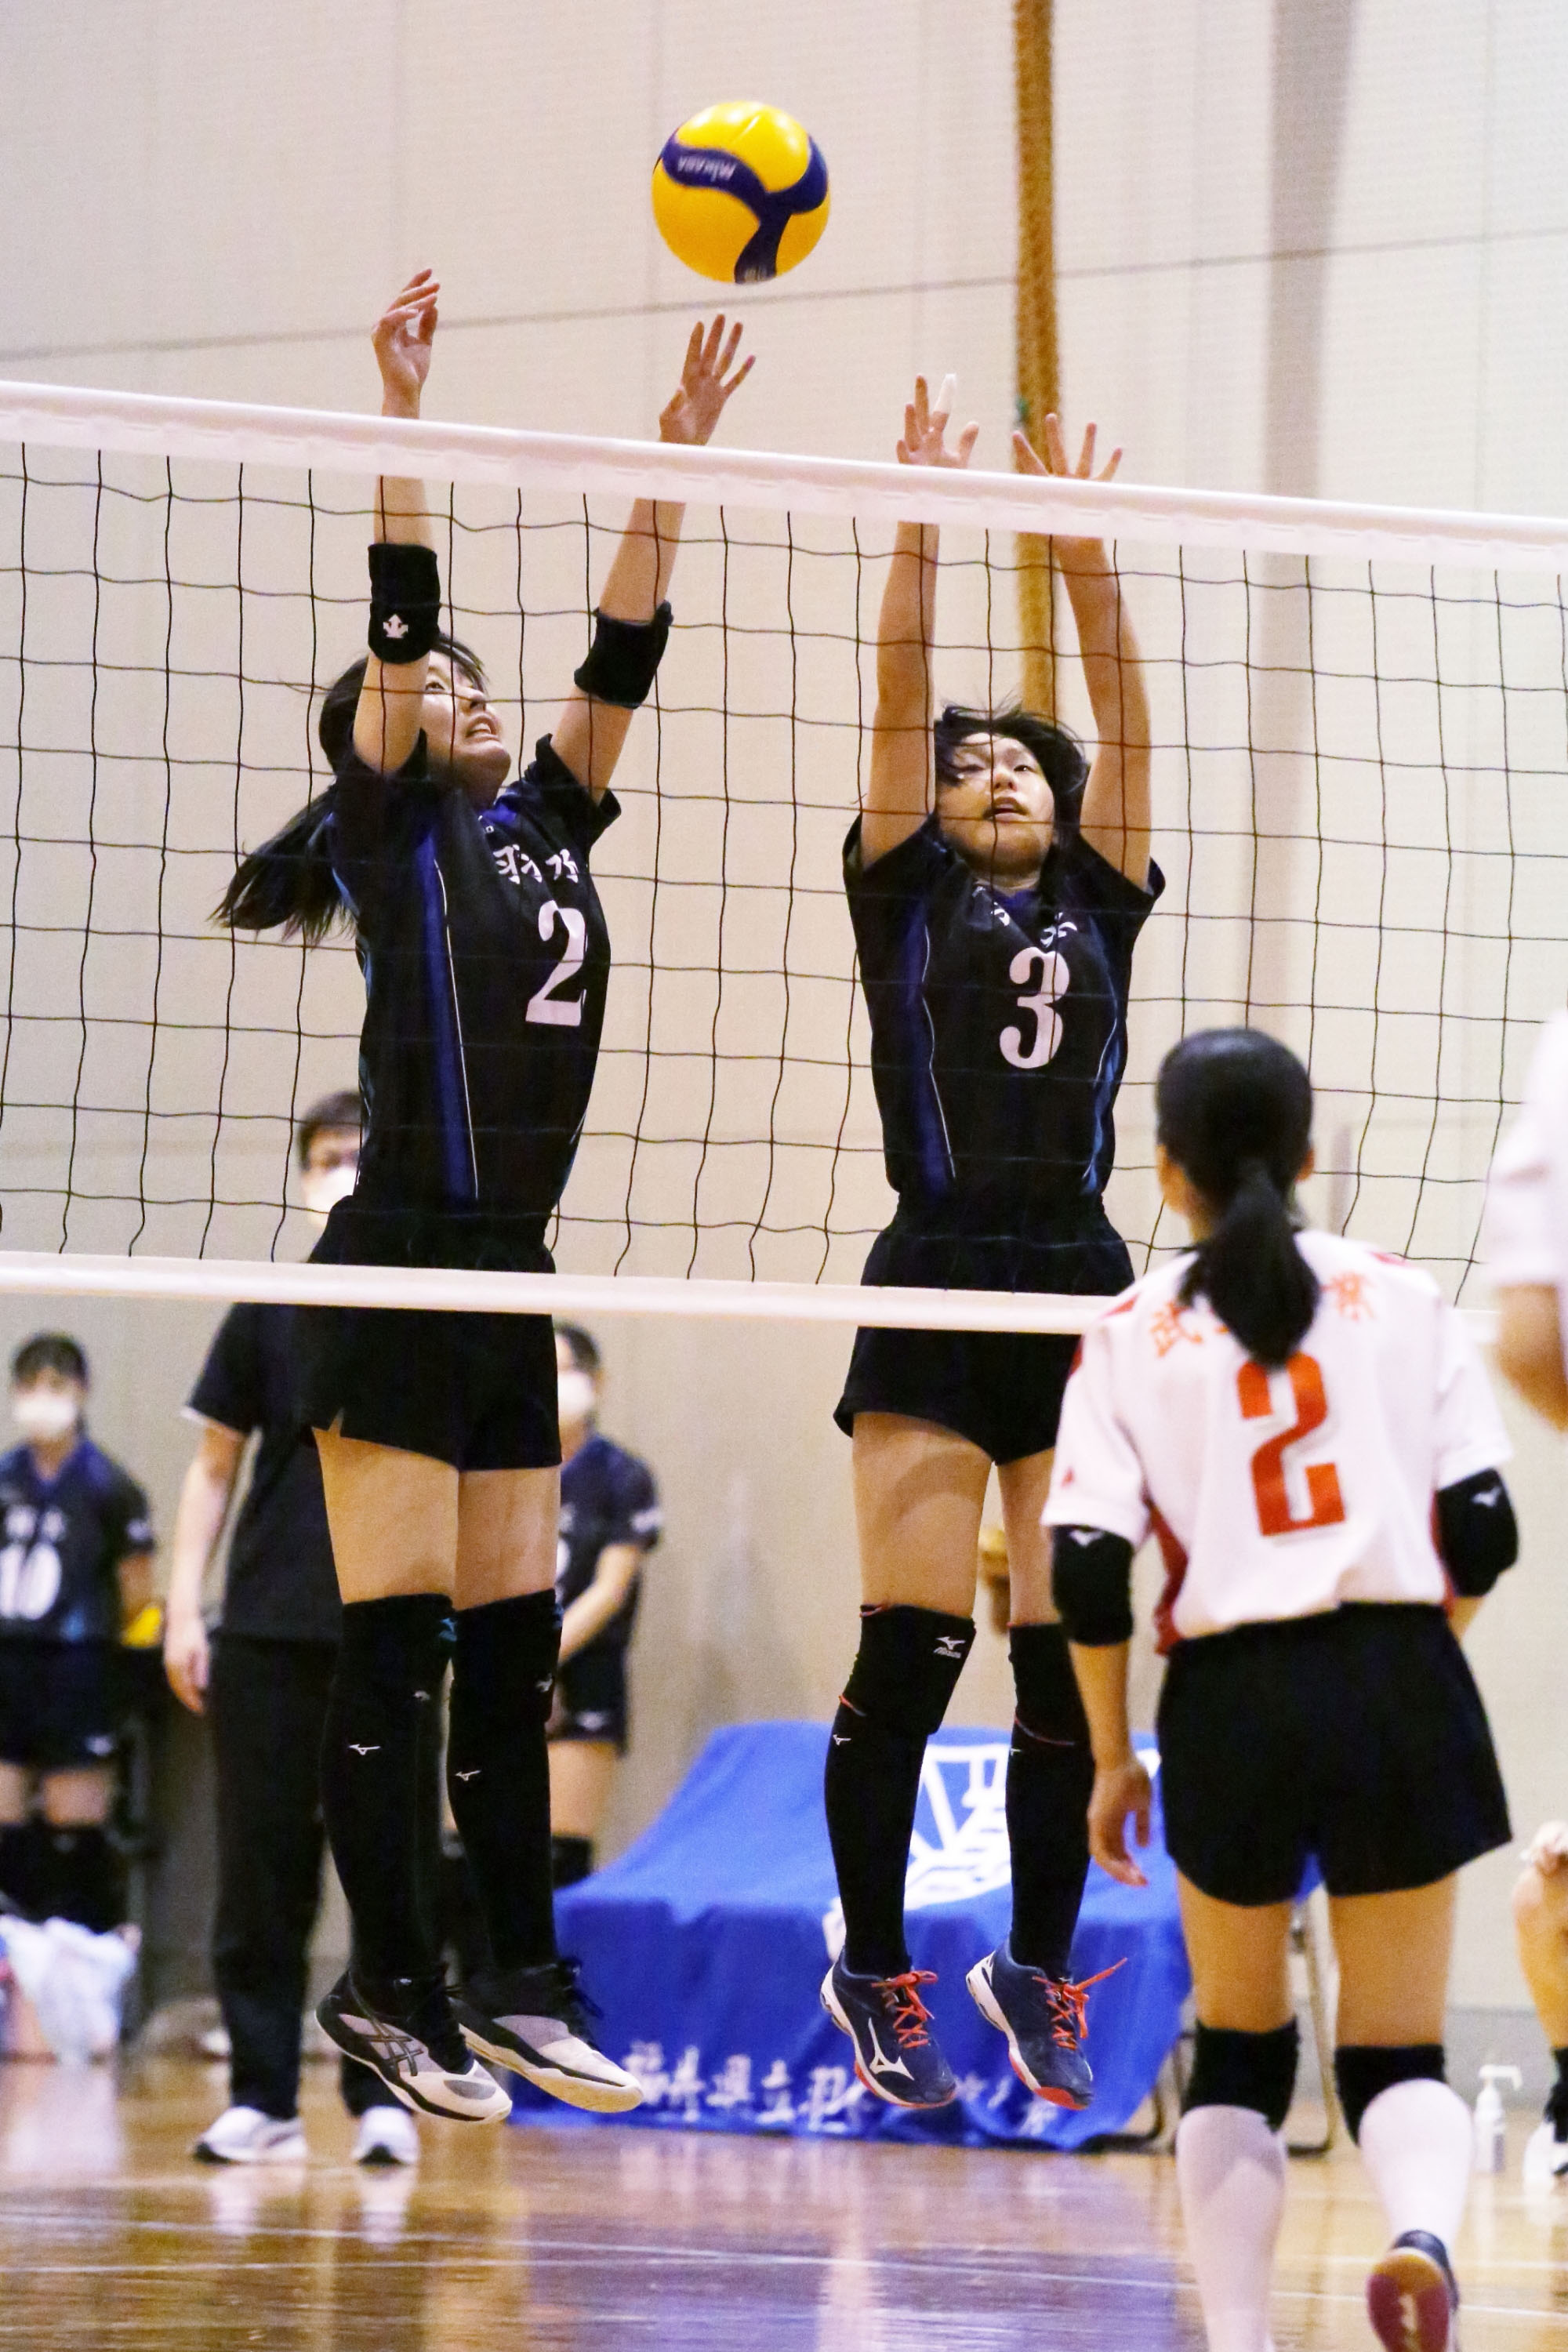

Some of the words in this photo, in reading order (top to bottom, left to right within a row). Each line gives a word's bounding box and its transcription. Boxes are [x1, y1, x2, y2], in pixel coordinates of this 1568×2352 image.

[525, 900, 586, 1027] 2
[1000, 946, 1070, 1069] 3
[1237, 1352, 1346, 1537] 2
